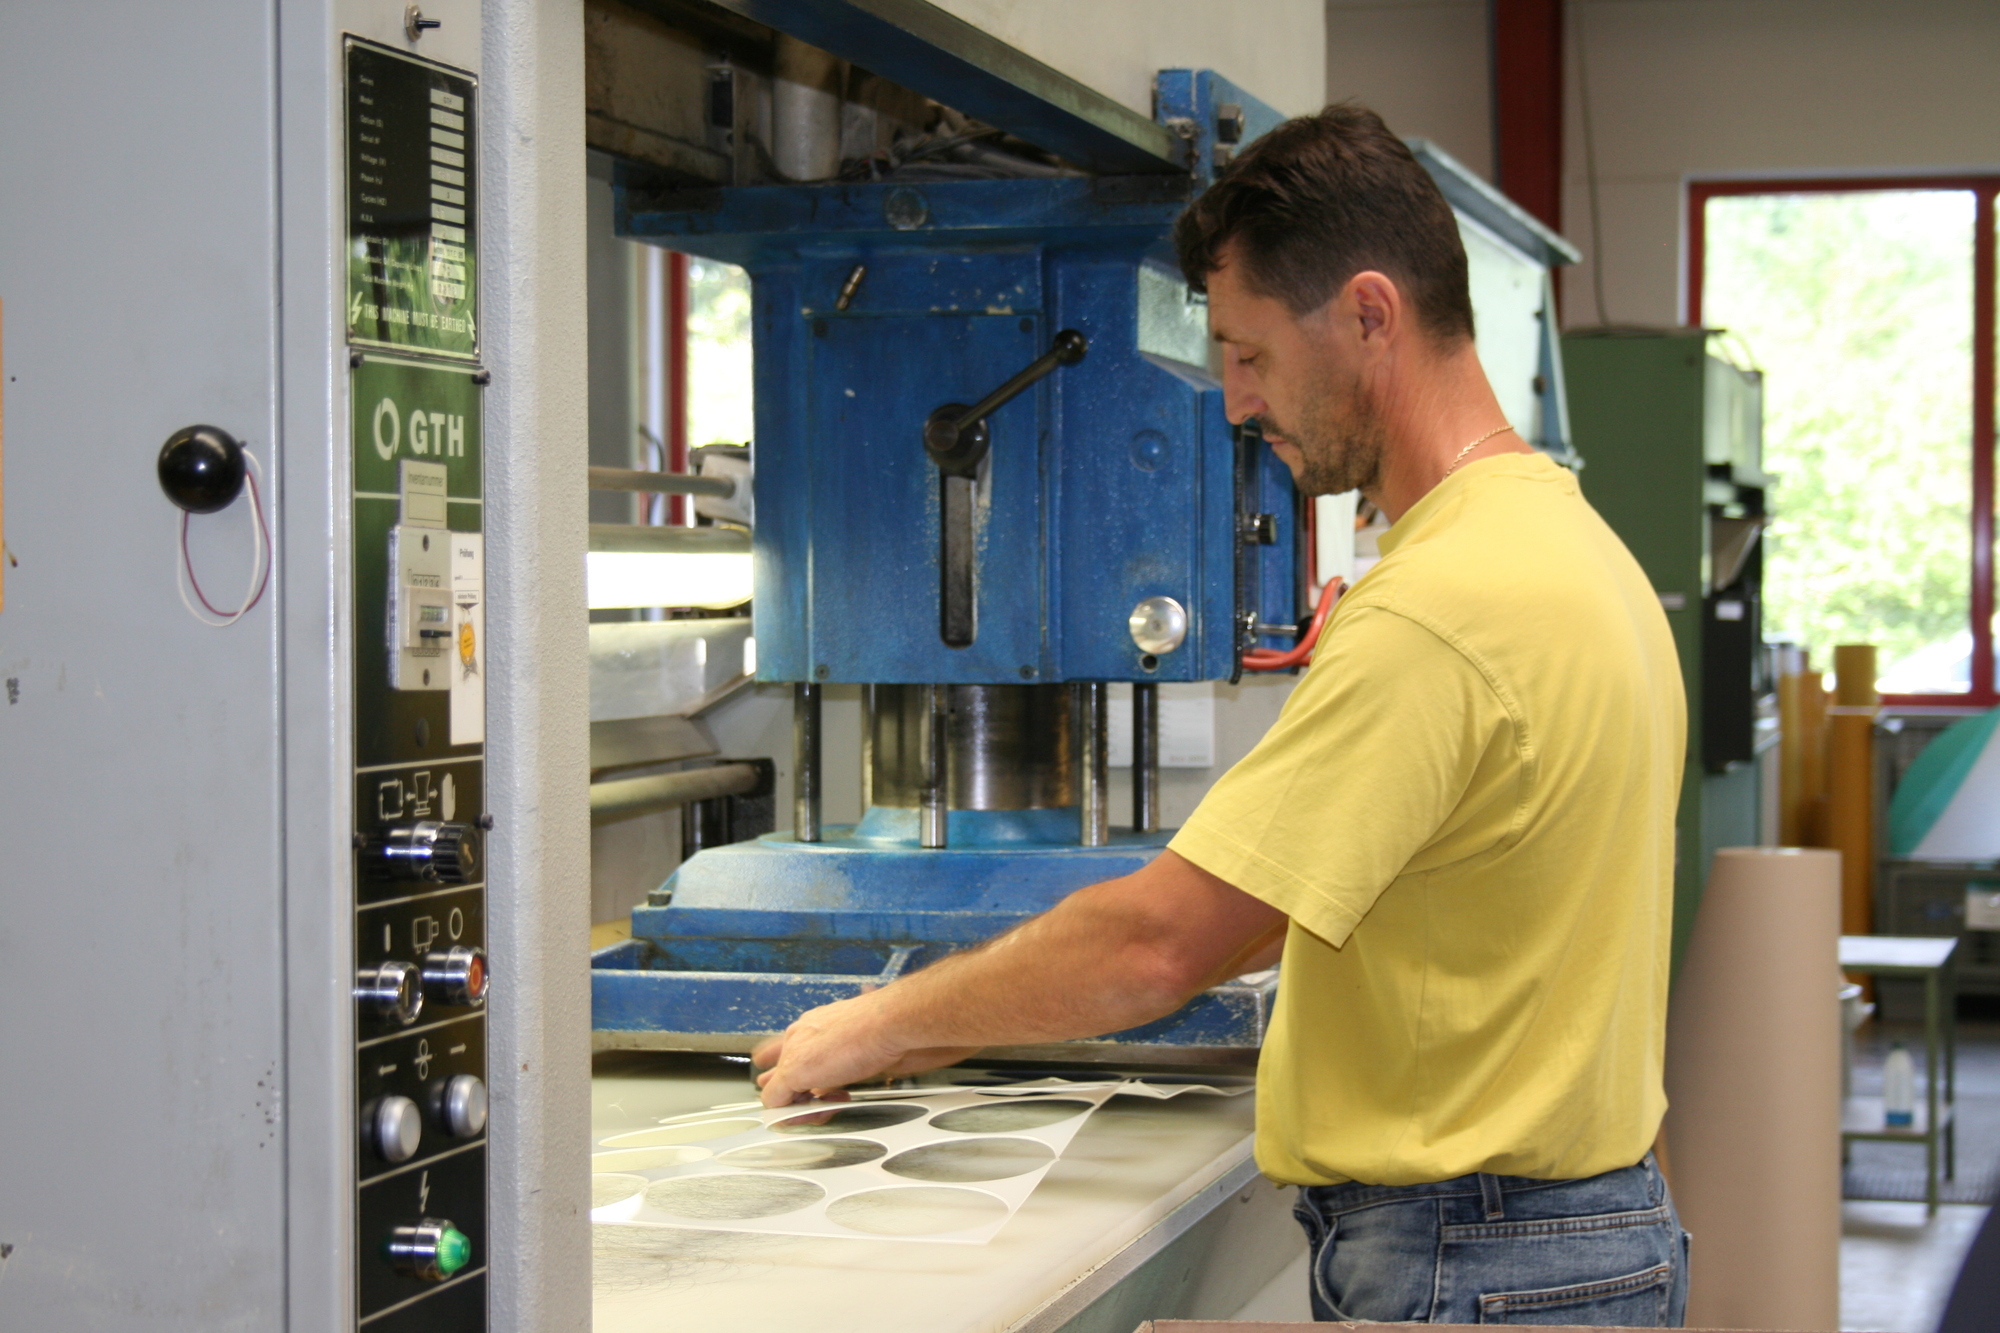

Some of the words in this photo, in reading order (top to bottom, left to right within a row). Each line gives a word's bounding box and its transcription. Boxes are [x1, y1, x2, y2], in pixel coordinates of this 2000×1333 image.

[361, 153, 378, 165] Voltage
[364, 303, 379, 320] THIS
[382, 307, 410, 325] MACHINE
[412, 311, 429, 328] MUST
[430, 314, 439, 329] BE
[441, 316, 466, 333] EARTHED
[409, 409, 464, 457] GTH
